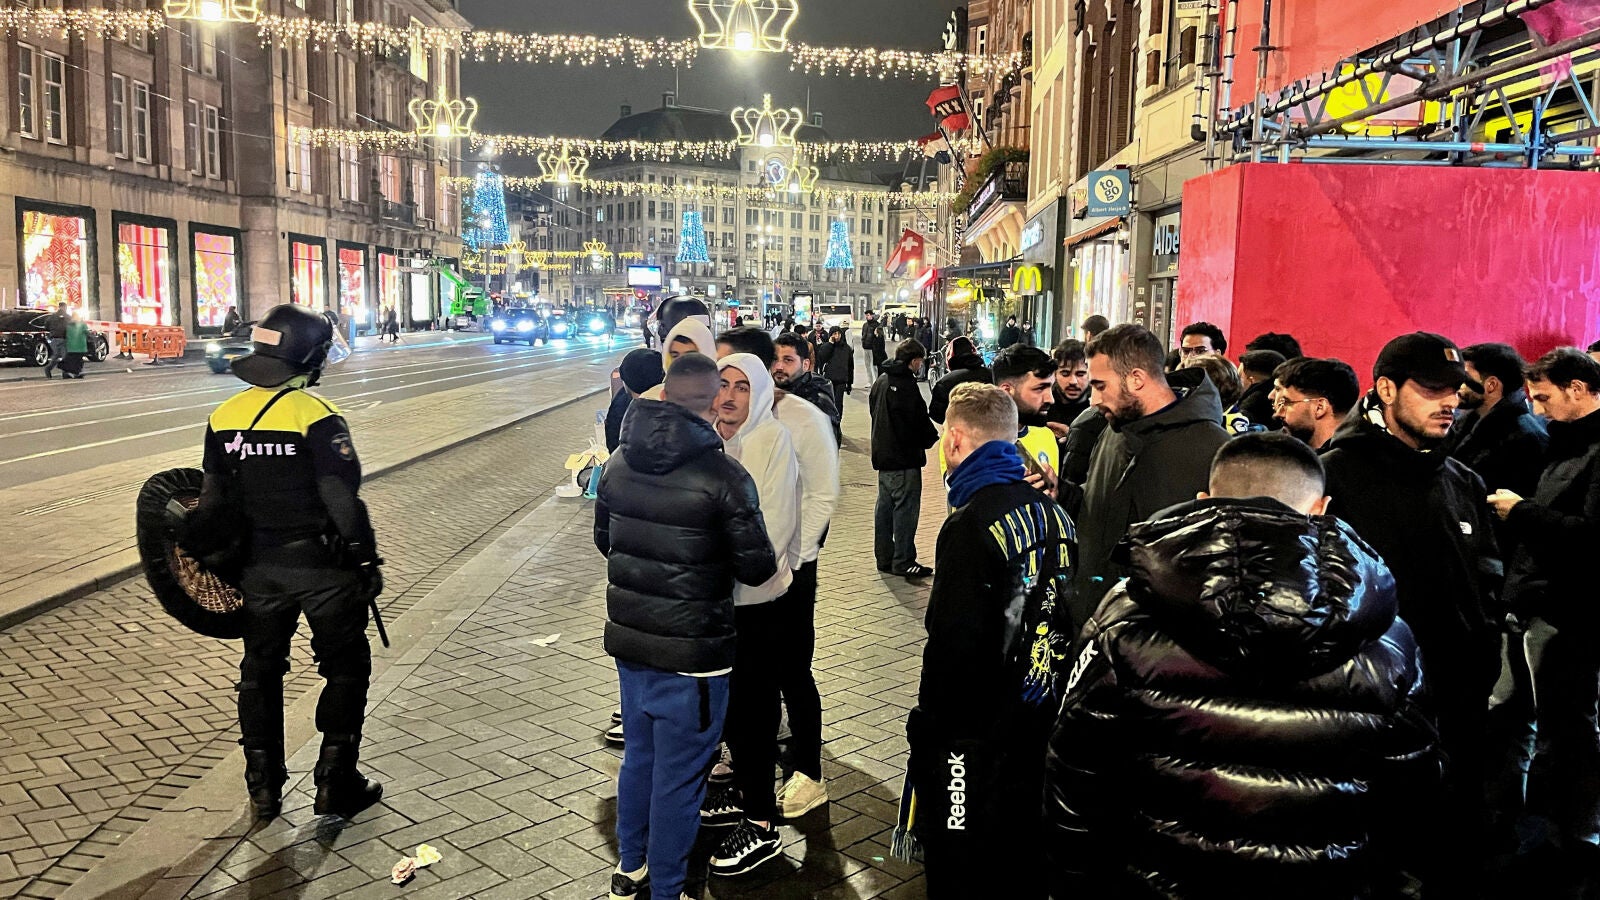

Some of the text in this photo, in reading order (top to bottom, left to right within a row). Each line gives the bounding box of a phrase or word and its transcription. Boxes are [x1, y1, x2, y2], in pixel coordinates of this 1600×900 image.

[1100, 179, 1113, 190] to
[1104, 186, 1120, 201] go
[947, 751, 966, 830] Reebok
